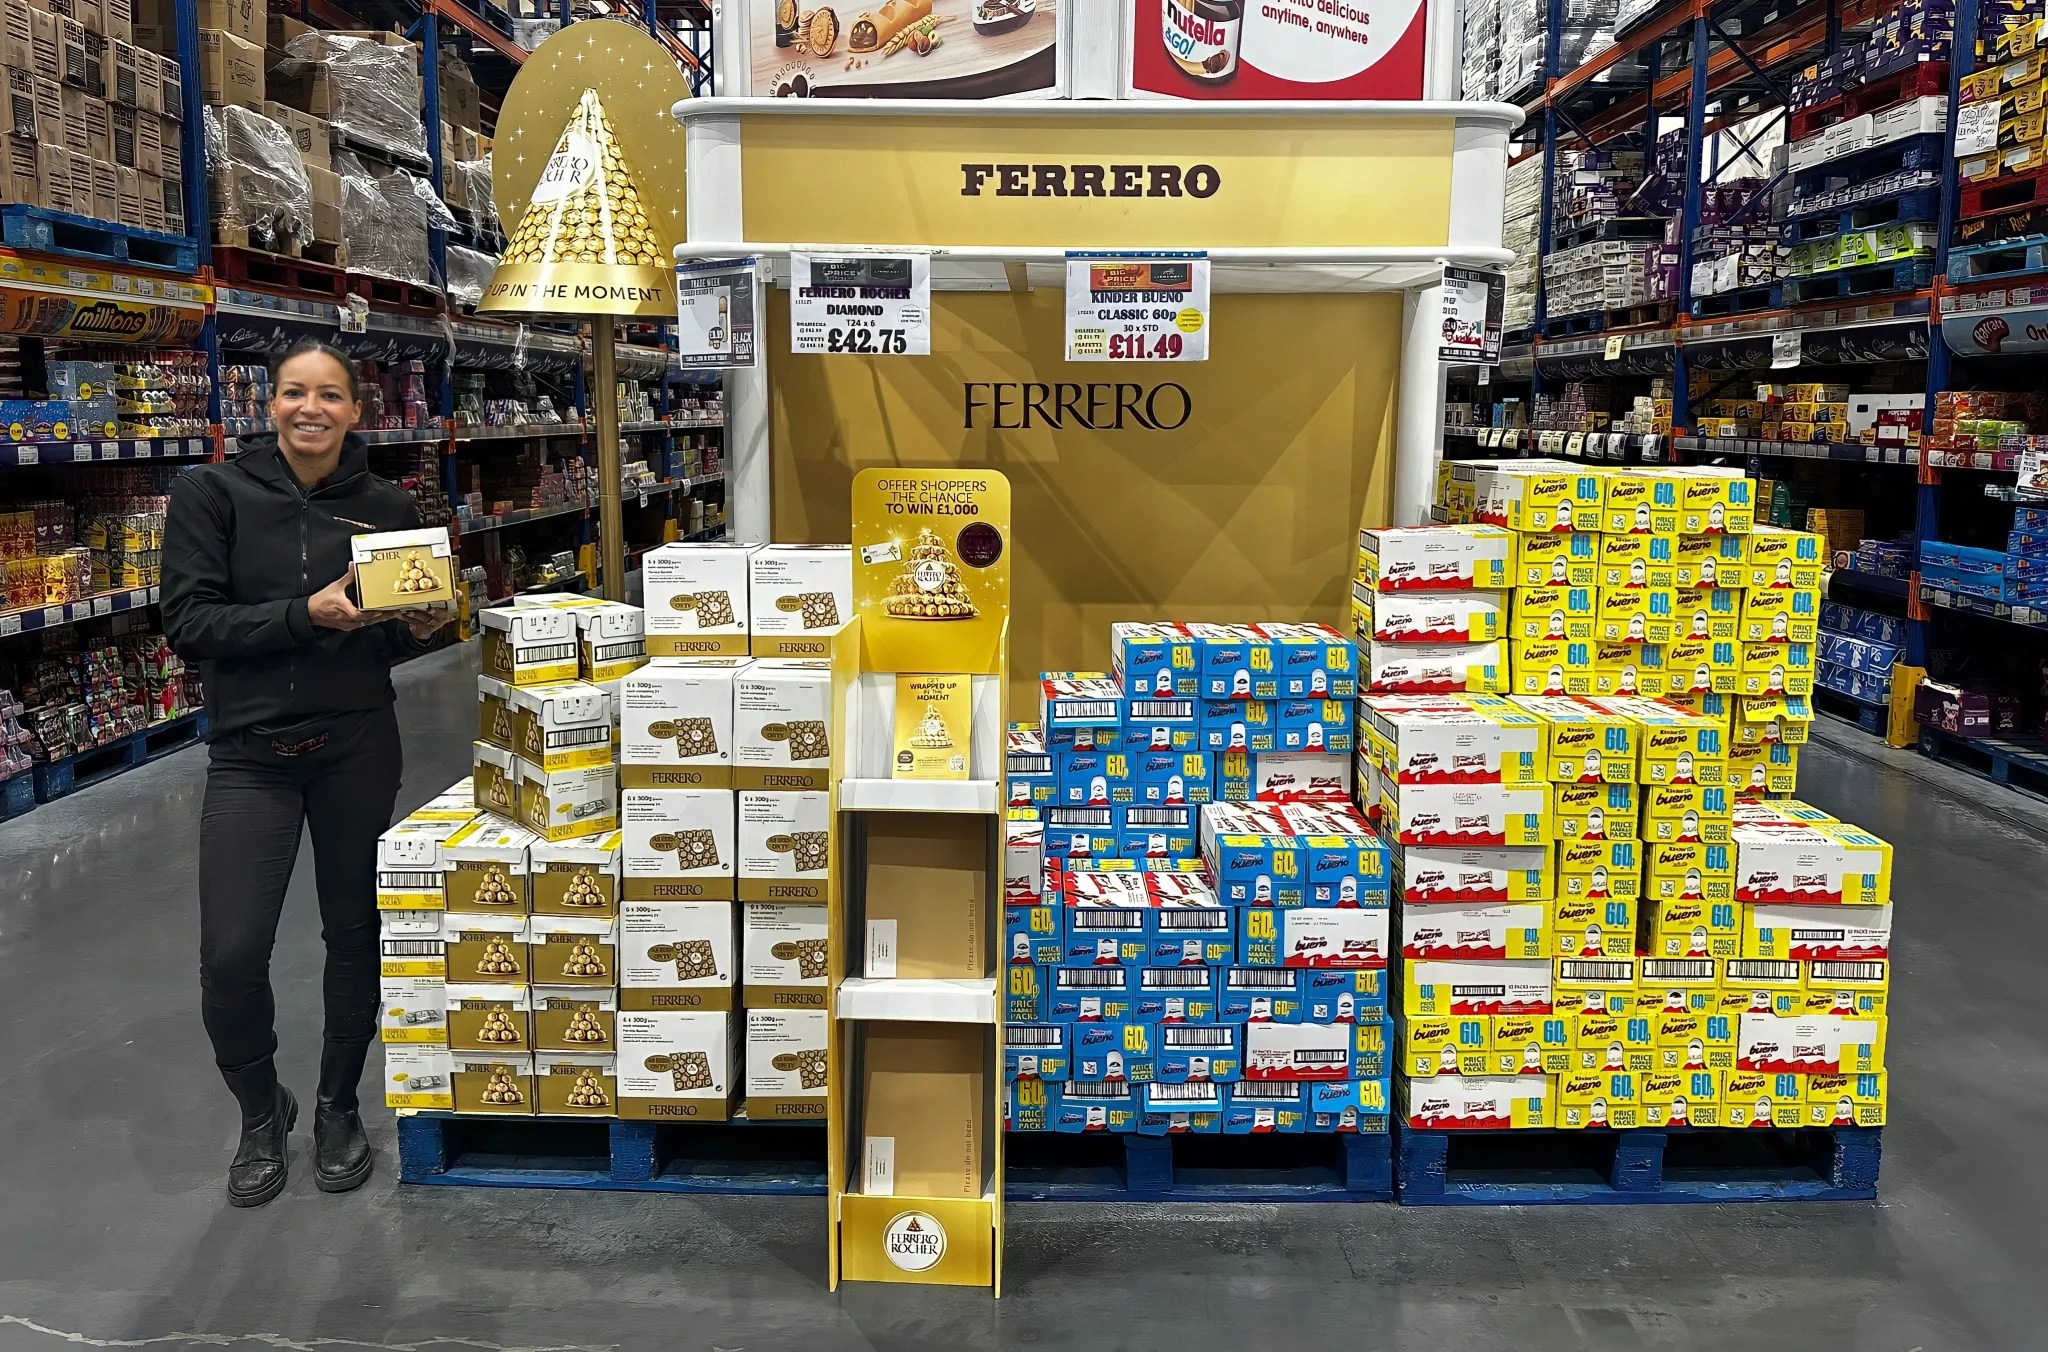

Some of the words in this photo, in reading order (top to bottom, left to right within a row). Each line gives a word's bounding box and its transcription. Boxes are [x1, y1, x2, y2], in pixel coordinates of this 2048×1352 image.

[1317, 0, 1369, 25] delicious
[1168, 4, 1225, 46] nutella
[1262, 5, 1312, 32] anytime,
[1316, 21, 1368, 44] anywhere
[1165, 27, 1195, 59] &GO!
[961, 164, 1221, 199] FERRERO
[510, 285, 527, 297] IN
[533, 285, 567, 298] THE
[574, 286, 662, 301] MOMENT
[799, 287, 856, 298] FERRERO
[860, 288, 910, 299] ROCHER
[1092, 292, 1138, 303] KINDER
[1142, 291, 1183, 303] BUENO
[827, 305, 883, 315] DIAMOND
[1098, 309, 1148, 320] CLASSIC
[1153, 309, 1176, 321] 60p
[76, 307, 142, 330] millions
[733, 332, 751, 343] BLACK
[1486, 331, 1499, 340] BLACK
[1974, 320, 2004, 345] Barratt
[828, 328, 907, 353] £42.75
[1109, 334, 1182, 358] £11.49
[733, 343, 752, 354] FRIDAY
[963, 383, 1192, 429] FERRERO
[878, 480, 917, 490] OFFER
[921, 480, 986, 491] SHOPPERS
[1534, 483, 1568, 494] bueno
[1612, 485, 1645, 497] bueno
[891, 492, 915, 502] THE
[920, 492, 973, 503] CHANCE
[1687, 486, 1720, 498] bueno
[885, 504, 903, 514] TO
[908, 504, 933, 514] WIN
[937, 504, 978, 516] £1,000
[1527, 539, 1561, 551] bueno
[1606, 541, 1640, 553] bueno
[1754, 541, 1787, 553] bueno
[1389, 564, 1415, 574] bueno
[1607, 596, 1640, 607] bueno
[1751, 595, 1784, 607] bueno
[674, 642, 720, 652] FERRERO
[779, 643, 825, 653] FERRERO
[1672, 646, 1704, 658] bueno
[1557, 733, 1595, 745] bueno
[1650, 735, 1688, 748] bueno
[1409, 756, 1438, 767] bueno
[652, 772, 702, 784] FERRERO
[764, 775, 813, 786] FERRERO
[1266, 777, 1296, 787] bueno
[1659, 851, 1696, 864] bueno
[654, 885, 703, 895] FERRERO
[769, 886, 818, 897] FERRERO
[1414, 930, 1442, 942] bueno
[1295, 940, 1327, 951] bueno
[1009, 967, 1039, 998] 60p
[652, 995, 701, 1005] FERRERO
[774, 993, 823, 1004] FERRERO
[1414, 1027, 1450, 1040] bueno
[1582, 1024, 1618, 1037] bueno
[1750, 1044, 1779, 1055] bueno
[1464, 1056, 1486, 1064] PRICE
[1566, 1080, 1602, 1093] bueno
[1729, 1079, 1765, 1092] bueno
[649, 1105, 697, 1115] FERRERO
[776, 1104, 824, 1114] FERRERO
[891, 1234, 938, 1244] FERRERO
[892, 1244, 938, 1255] ROCHER
